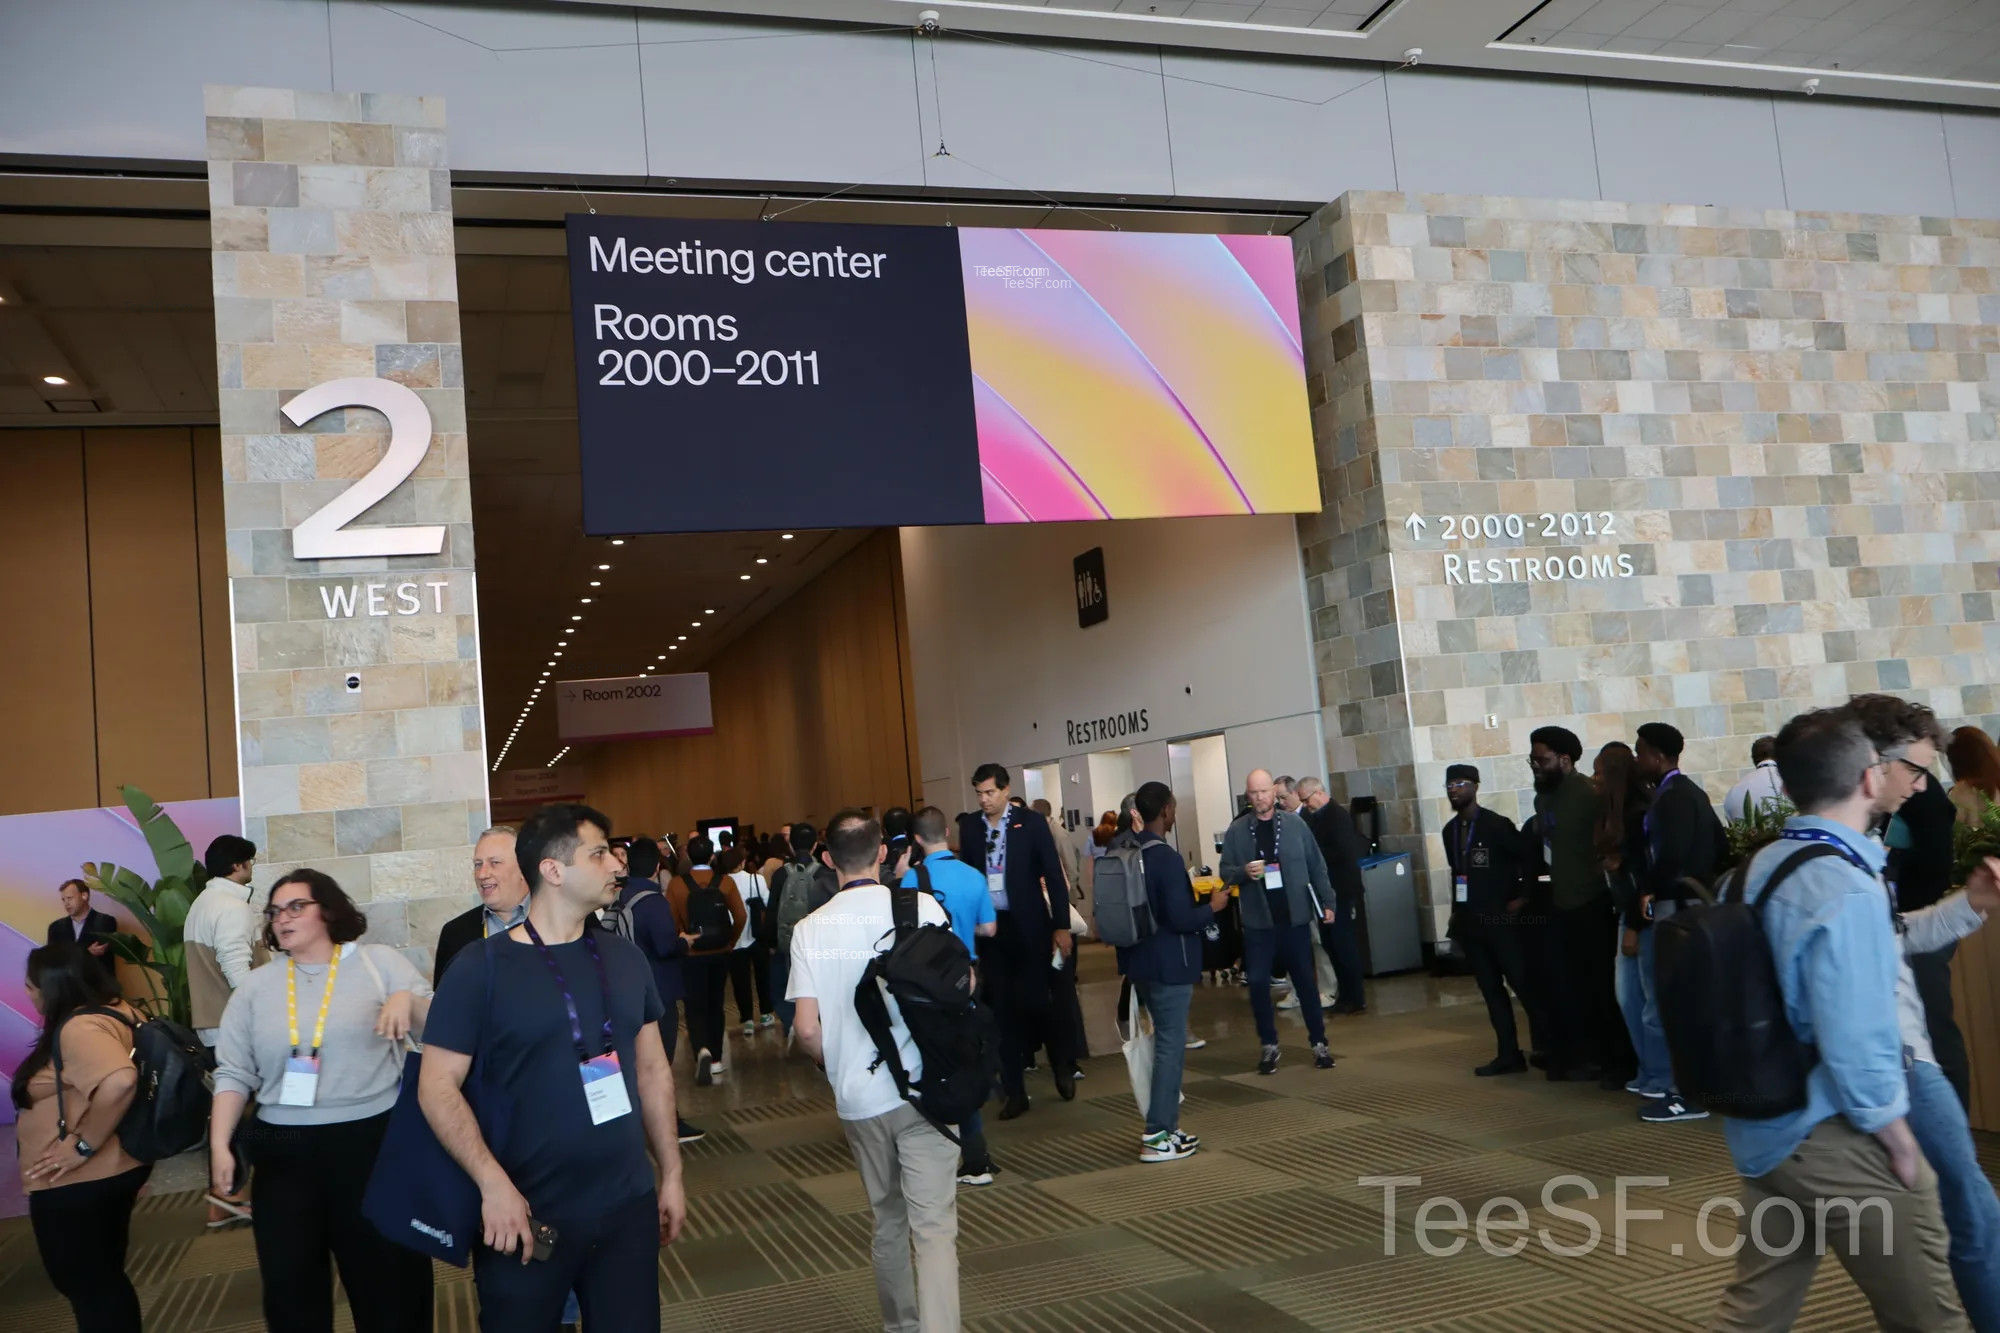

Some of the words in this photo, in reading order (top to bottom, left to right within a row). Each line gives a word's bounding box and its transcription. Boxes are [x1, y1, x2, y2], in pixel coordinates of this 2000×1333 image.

[588, 235, 756, 285] Meeting
[764, 244, 888, 279] center
[593, 303, 739, 342] Rooms
[280, 376, 446, 559] 2
[1437, 511, 1617, 541] 2000-2012
[1442, 552, 1635, 586] RESTROOMS
[319, 581, 449, 619] WEST
[582, 688, 624, 702] Room
[625, 683, 662, 699] 2002
[1066, 708, 1150, 747] RESTROOMS
